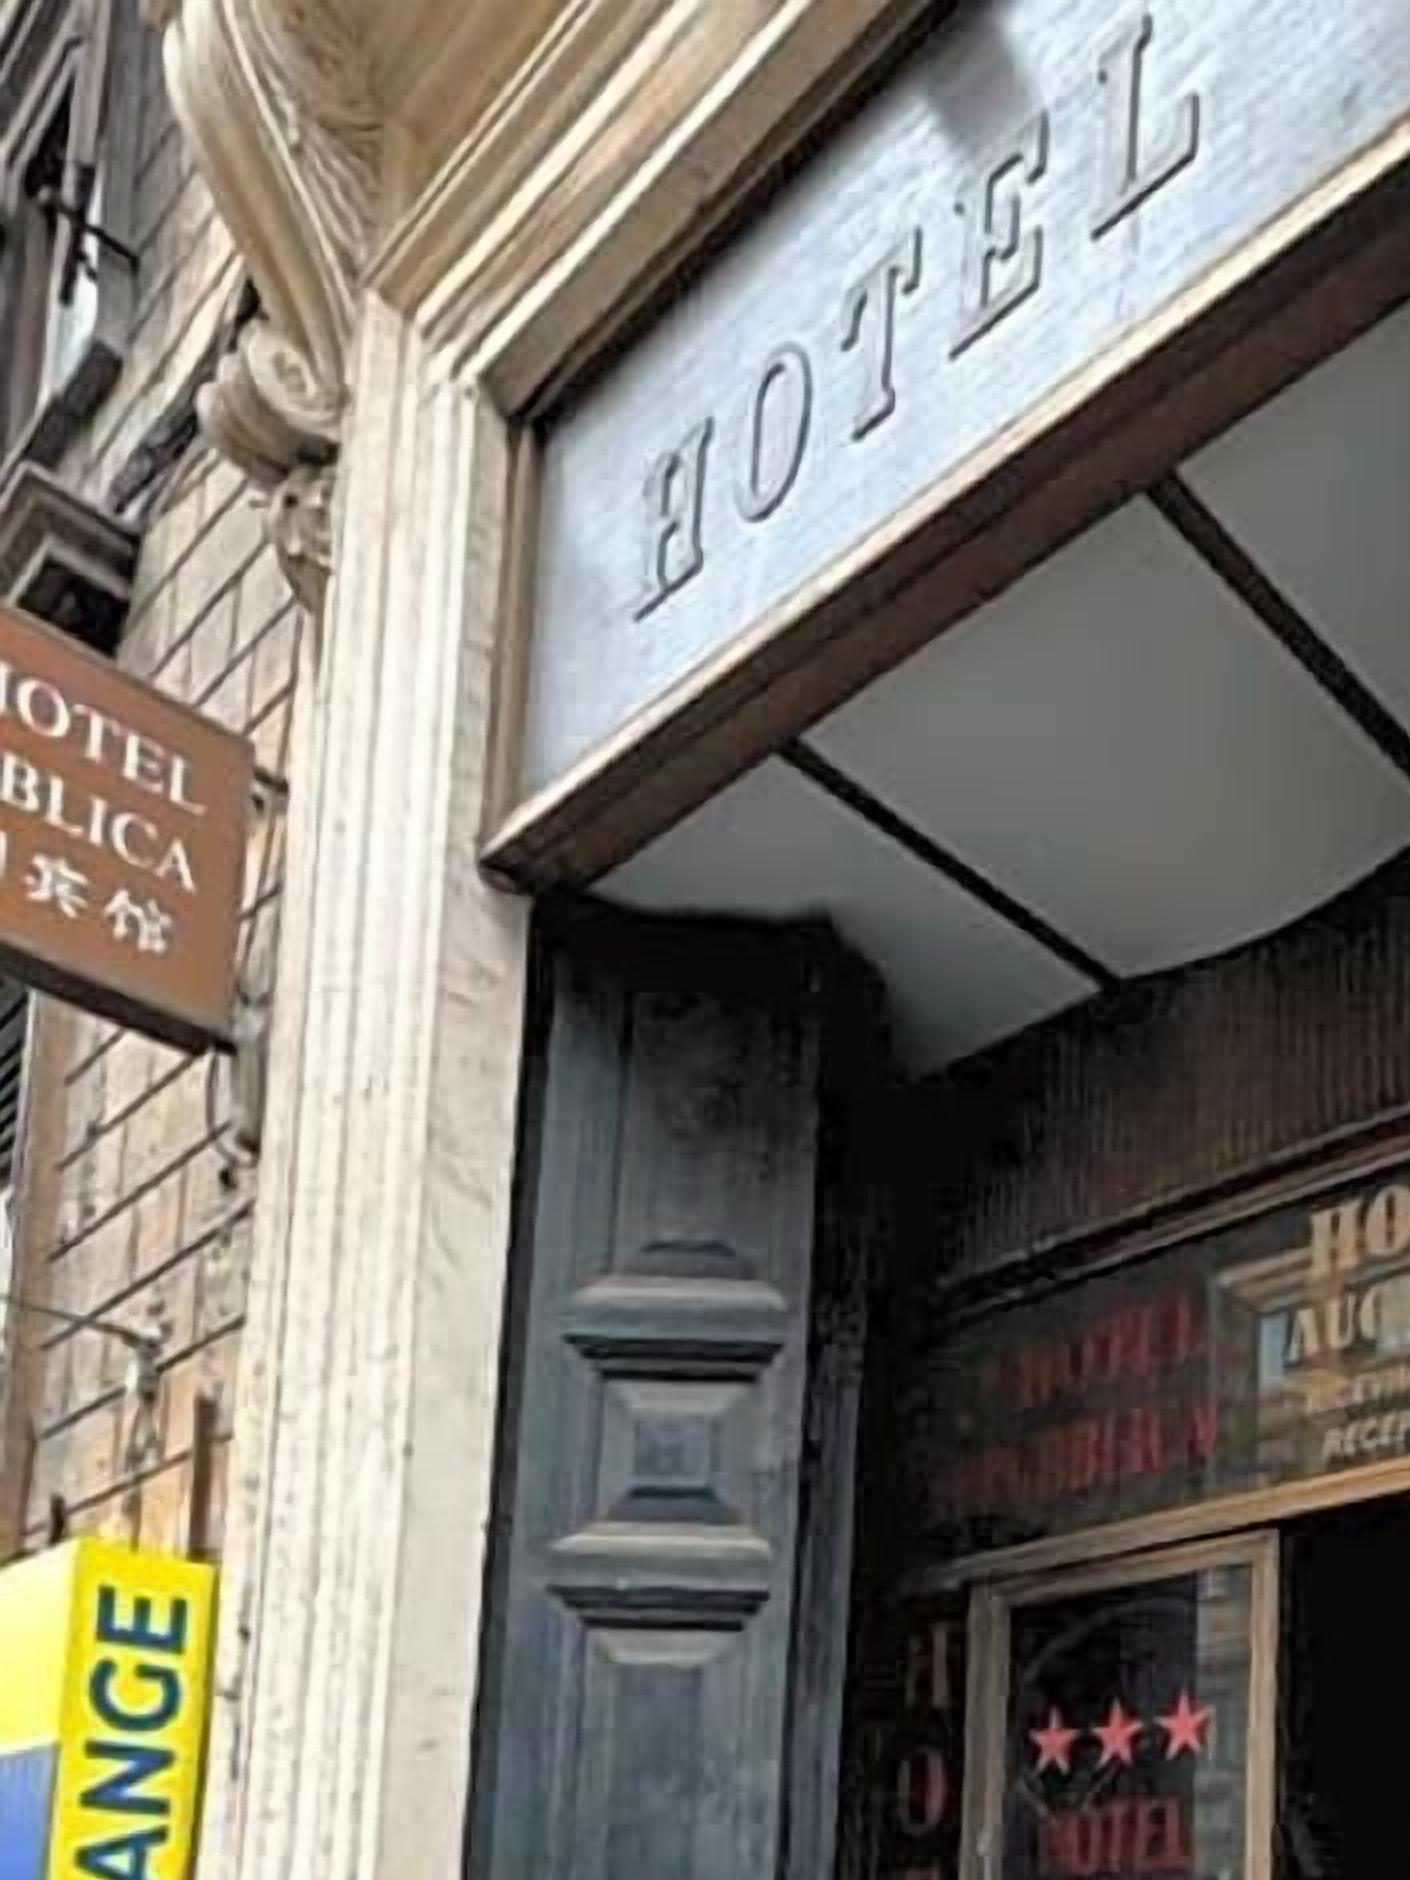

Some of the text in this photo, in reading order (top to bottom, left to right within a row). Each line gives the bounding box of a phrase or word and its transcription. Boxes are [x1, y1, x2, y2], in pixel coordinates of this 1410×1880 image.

[634, 12, 1201, 622] HOTEL
[0, 831, 173, 955] 宾馆
[1, 752, 197, 896] BLICA
